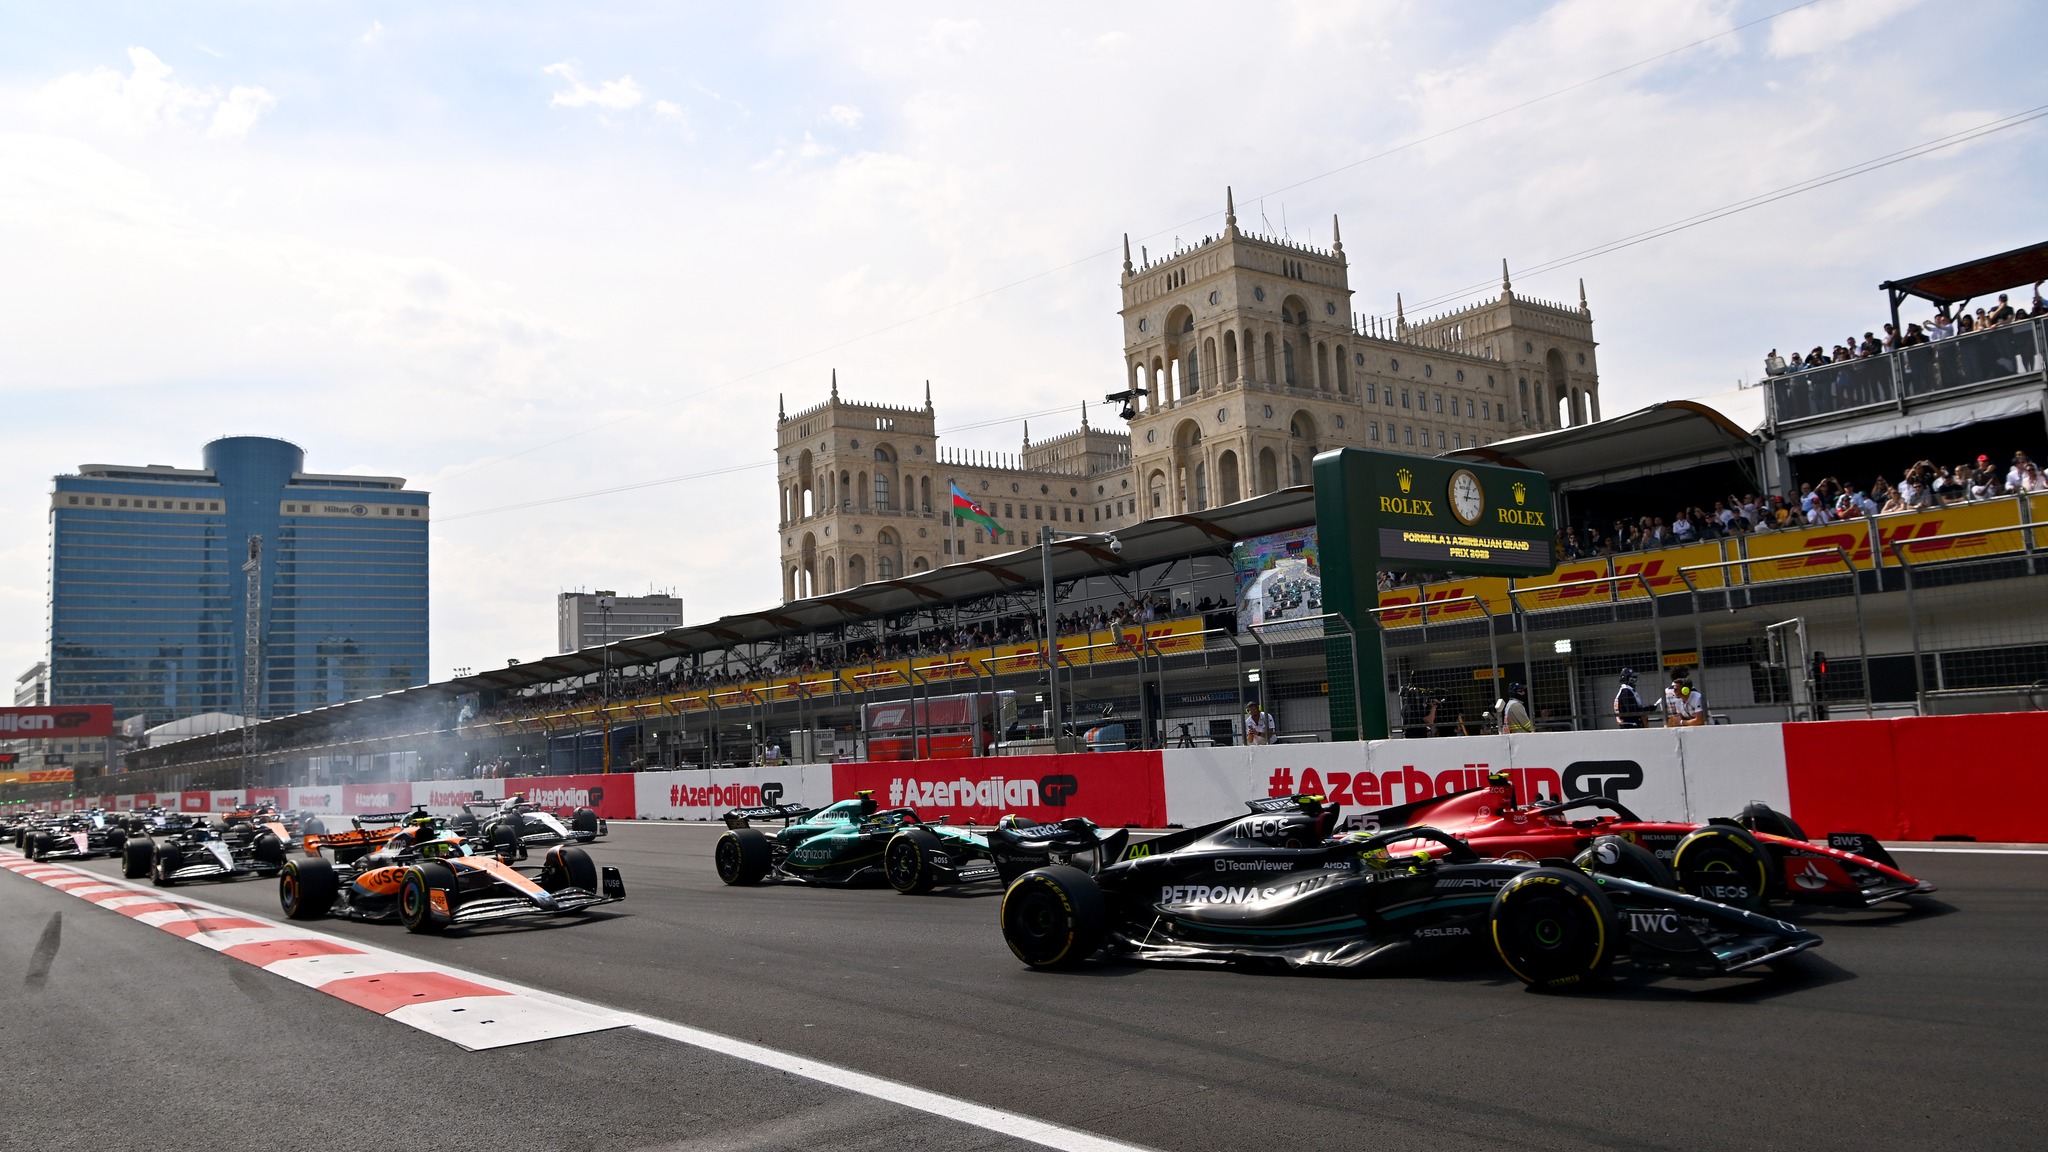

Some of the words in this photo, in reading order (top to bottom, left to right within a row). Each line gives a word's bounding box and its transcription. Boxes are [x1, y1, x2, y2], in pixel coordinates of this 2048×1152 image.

[324, 505, 349, 513] Hilton
[1379, 496, 1434, 517] ROLEX
[1497, 508, 1546, 527] ROLEX
[1403, 532, 1445, 544] FORMULA
[1445, 536, 1451, 545] 1
[1502, 540, 1530, 551] GRAND
[1803, 520, 1956, 567] DHL
[1449, 547, 1469, 558] PRIX
[1470, 549, 1490, 560] 2023
[1557, 559, 1673, 599] DHL
[1379, 588, 1472, 622] DHL
[1117, 628, 1177, 653] DHL
[855, 668, 895, 685] DHL
[929, 657, 973, 678] DHL
[0, 712, 91, 732] ijanGP
[1234, 818, 1289, 839] INEOS
[1346, 815, 1381, 834] 55
[1832, 835, 1862, 846] aws
[794, 847, 832, 862] cognizant
[933, 856, 948, 864] BOSS
[1129, 844, 1150, 860] 44
[1226, 859, 1294, 872] TeamViewer
[1460, 878, 1512, 888] AMG
[1512, 876, 1561, 892] ZERO
[1700, 885, 1749, 898] INEOS
[1045, 880, 1071, 912] ZERO
[1161, 885, 1277, 905] PETRONAS
[1423, 927, 1472, 938] SOLERA
[1629, 913, 1679, 933] IWC
